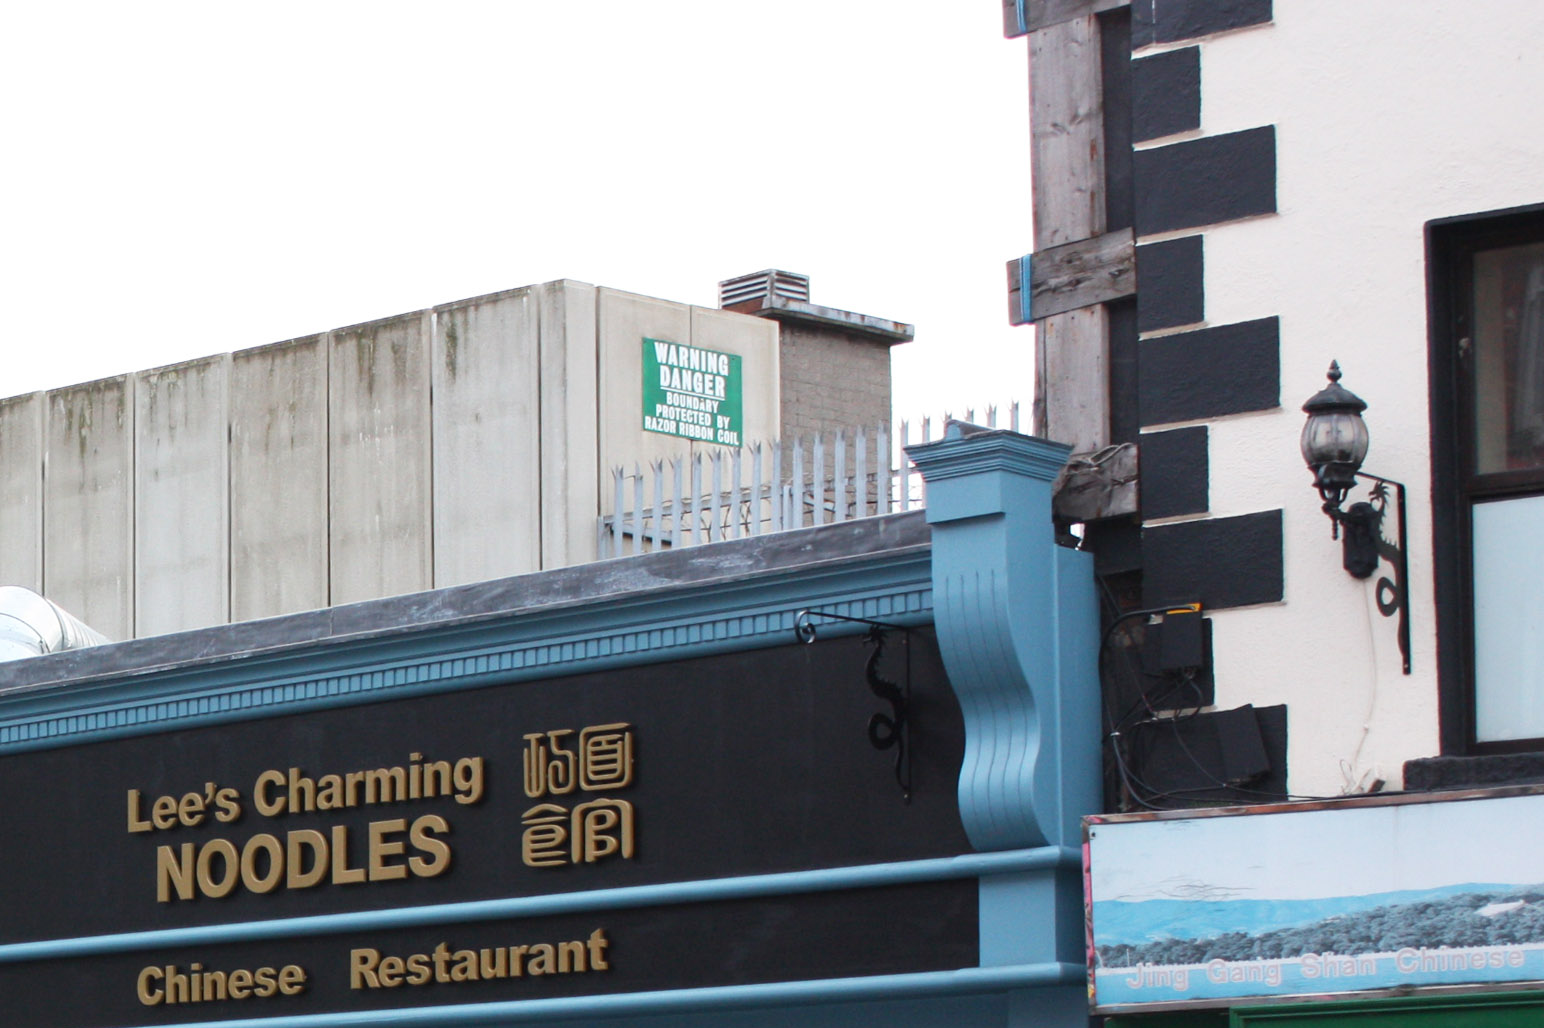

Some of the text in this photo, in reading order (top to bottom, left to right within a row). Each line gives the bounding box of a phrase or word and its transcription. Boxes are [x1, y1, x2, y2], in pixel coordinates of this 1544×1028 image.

[654, 341, 729, 377] WARNING
[660, 365, 726, 398] DANGER
[656, 404, 730, 429] PROTECTED BY
[666, 392, 719, 414] BOUNDARY
[644, 416, 739, 445] RAZOR RIBBON COIL
[127, 752, 484, 833] Lee's Charming
[156, 814, 451, 903] NOODLES
[136, 928, 609, 1005] Chinese Restaurant
[1126, 947, 1526, 991] Jing Gang Shan Chinese
